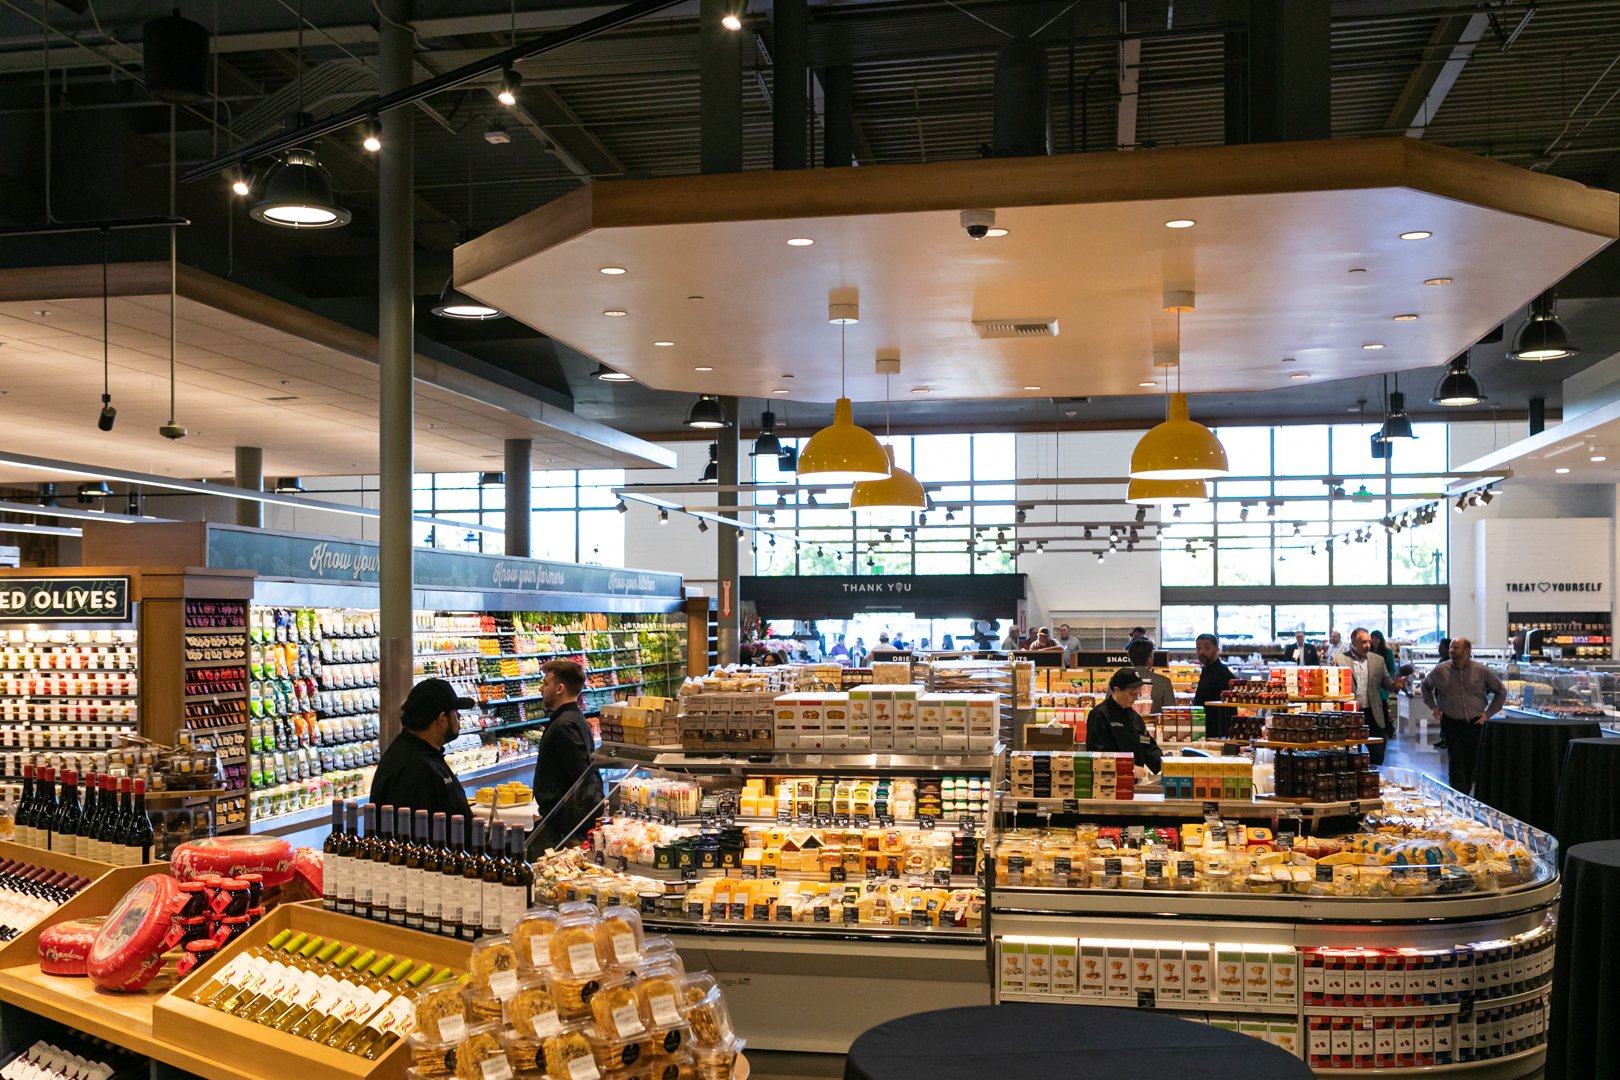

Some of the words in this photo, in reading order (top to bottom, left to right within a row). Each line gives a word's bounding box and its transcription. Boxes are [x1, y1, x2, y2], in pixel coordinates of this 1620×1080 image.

[310, 543, 352, 576] Know
[842, 583, 883, 592] THANK
[1506, 583, 1536, 592] TREAT
[1552, 582, 1602, 592] YOURSELF
[34, 591, 117, 609] OLIVES
